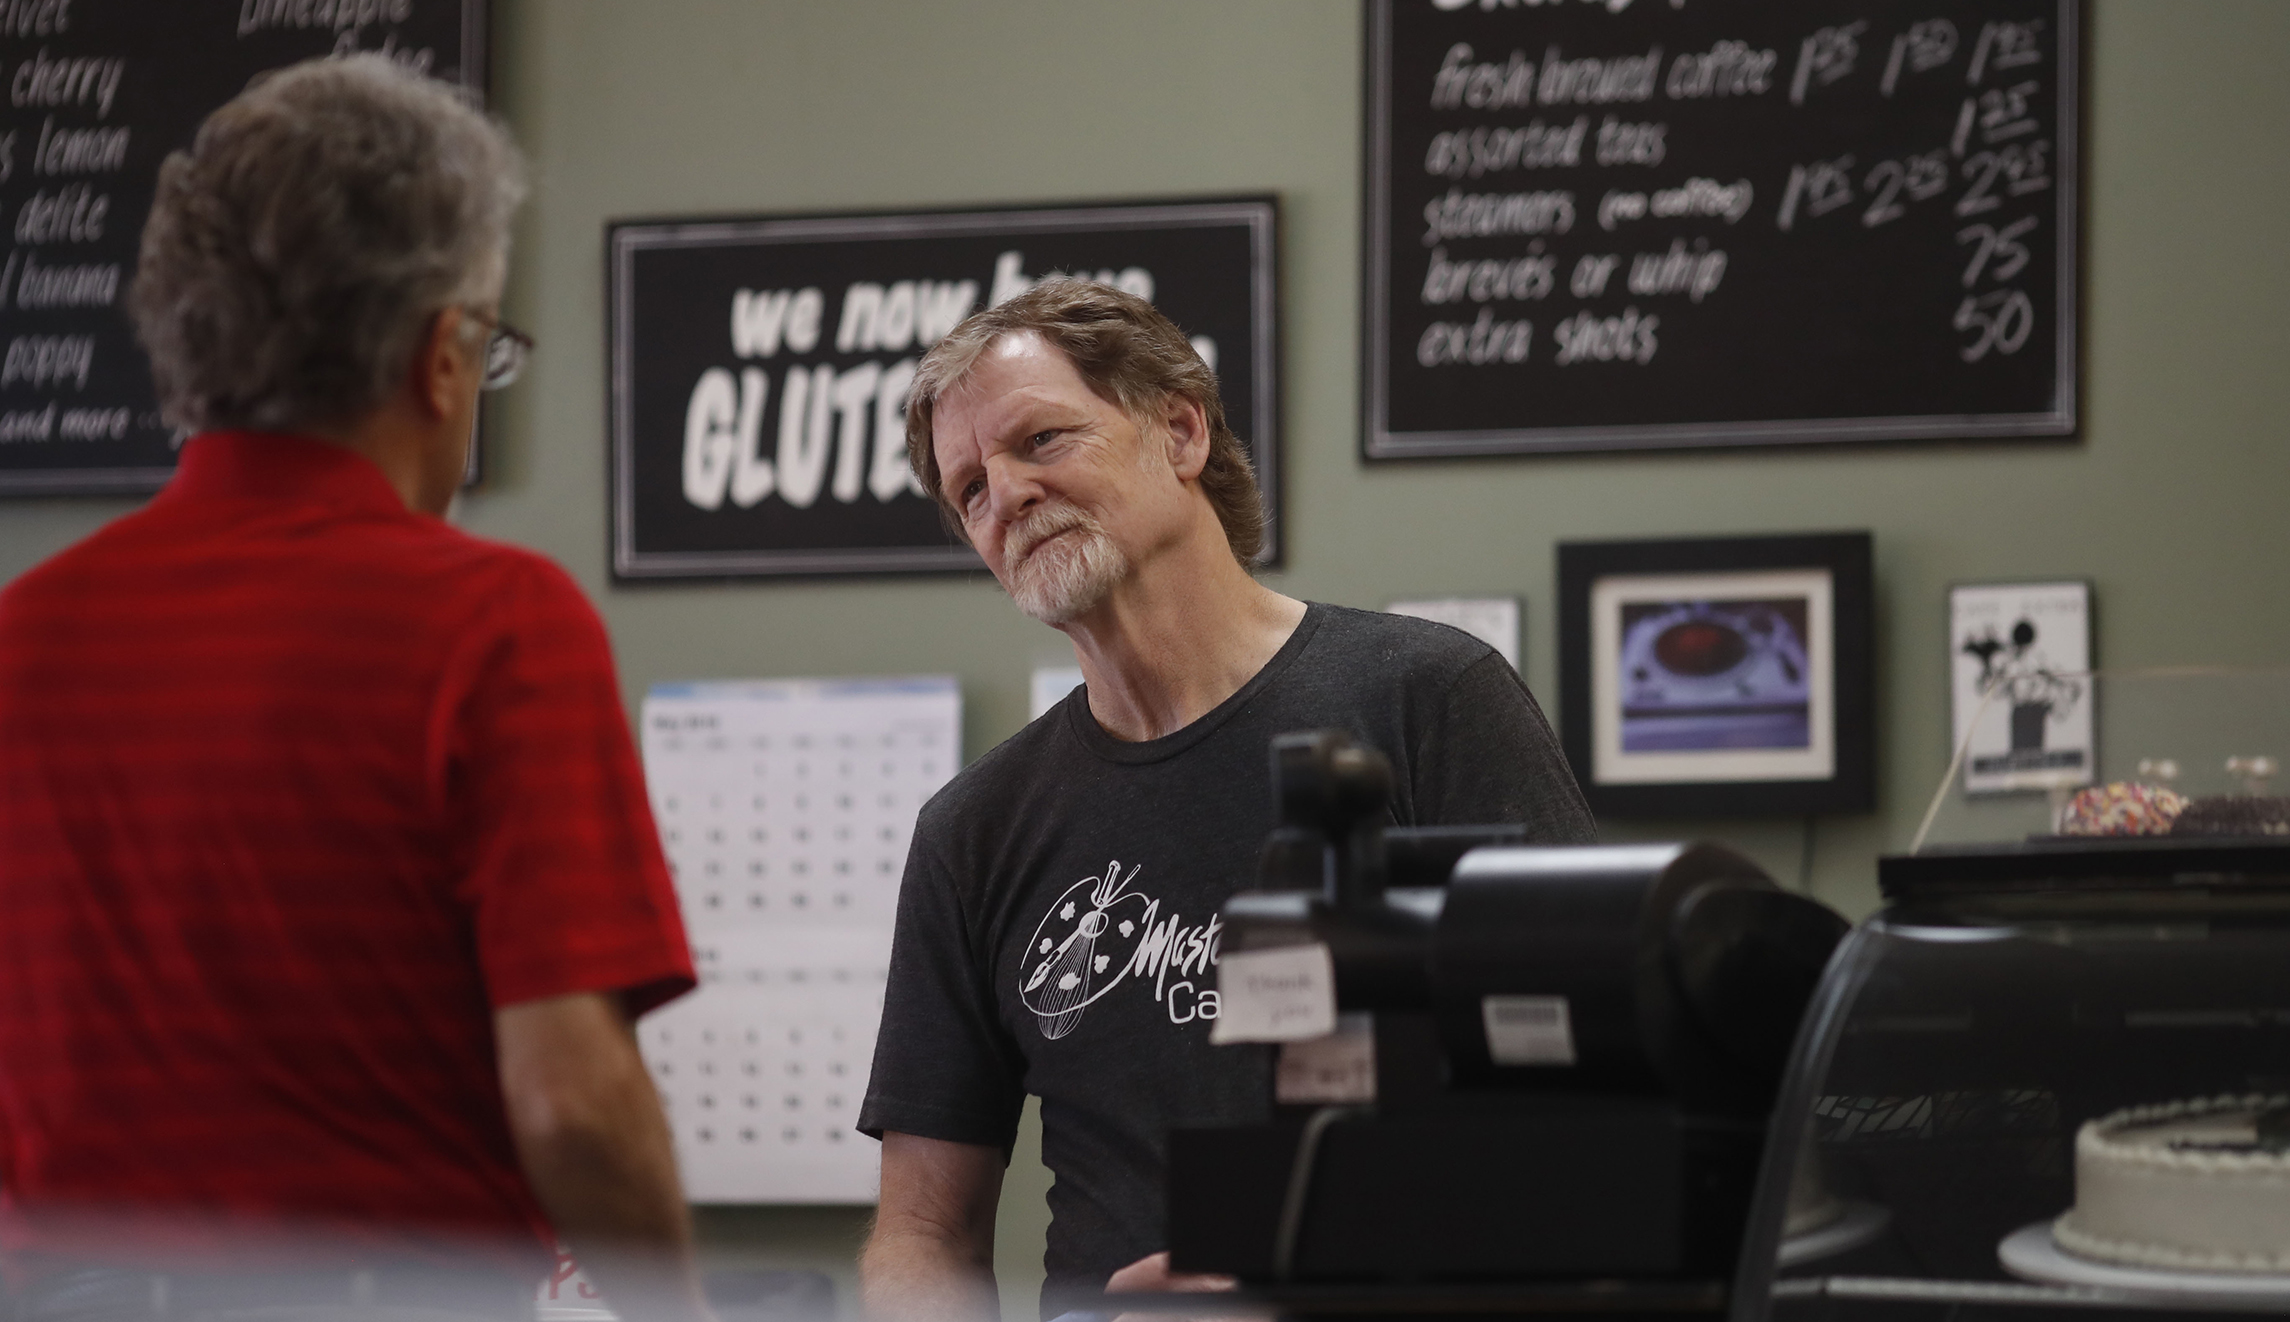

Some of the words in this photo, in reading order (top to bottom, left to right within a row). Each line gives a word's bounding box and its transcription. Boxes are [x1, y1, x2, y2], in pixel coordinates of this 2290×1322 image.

[11, 45, 126, 121] cherry
[1431, 42, 1536, 110] fresh
[1537, 44, 1664, 105] brewed
[1665, 39, 1777, 99] coffee
[33, 112, 131, 177] lemon
[1425, 114, 1590, 180] assorted
[1595, 113, 1667, 167] teas
[14, 181, 110, 246] delite
[1421, 186, 1575, 246] steamers
[16, 250, 121, 311] banana
[1570, 252, 1621, 298] or
[1627, 236, 1728, 303] whip
[1955, 213, 2039, 288] 75
[730, 286, 824, 359] we
[834, 278, 981, 352] now
[1417, 305, 1533, 367] extra
[1553, 305, 1660, 367] shots
[1953, 288, 2034, 363] 50
[1, 333, 95, 393] poppy
[0, 400, 57, 444] and
[59, 405, 130, 443] more
